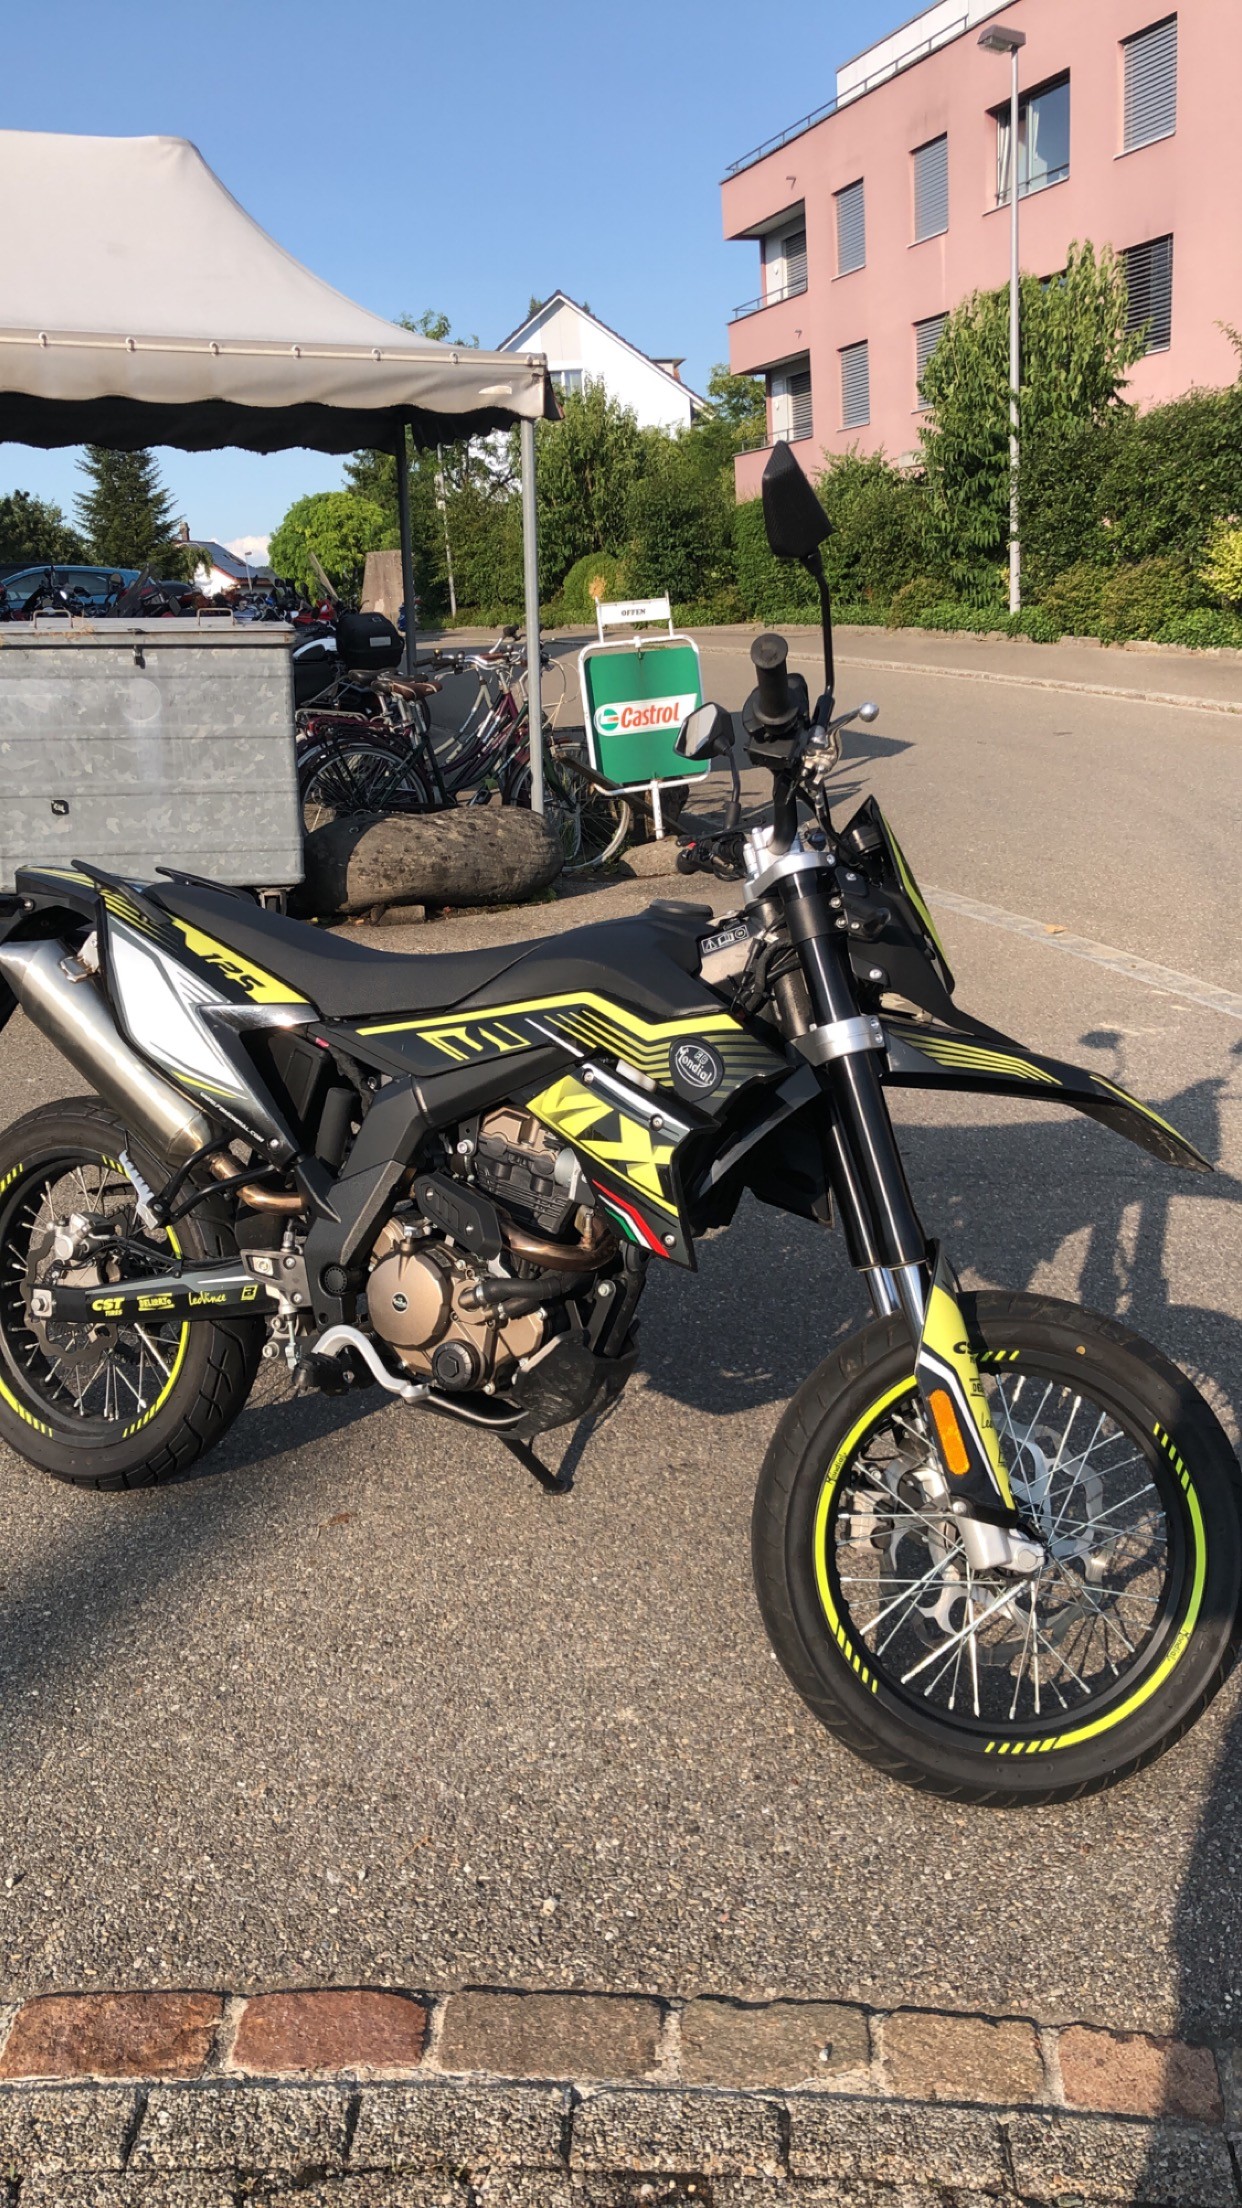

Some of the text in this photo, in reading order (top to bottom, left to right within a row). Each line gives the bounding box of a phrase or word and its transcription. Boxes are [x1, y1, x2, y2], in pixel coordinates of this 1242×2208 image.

[621, 608, 646, 616] OFFEN
[621, 702, 680, 729] Castrol
[200, 953, 266, 992] 125
[677, 1046, 713, 1084] Mondial
[92, 1297, 125, 1311] CST
[105, 1309, 123, 1317] TIRES
